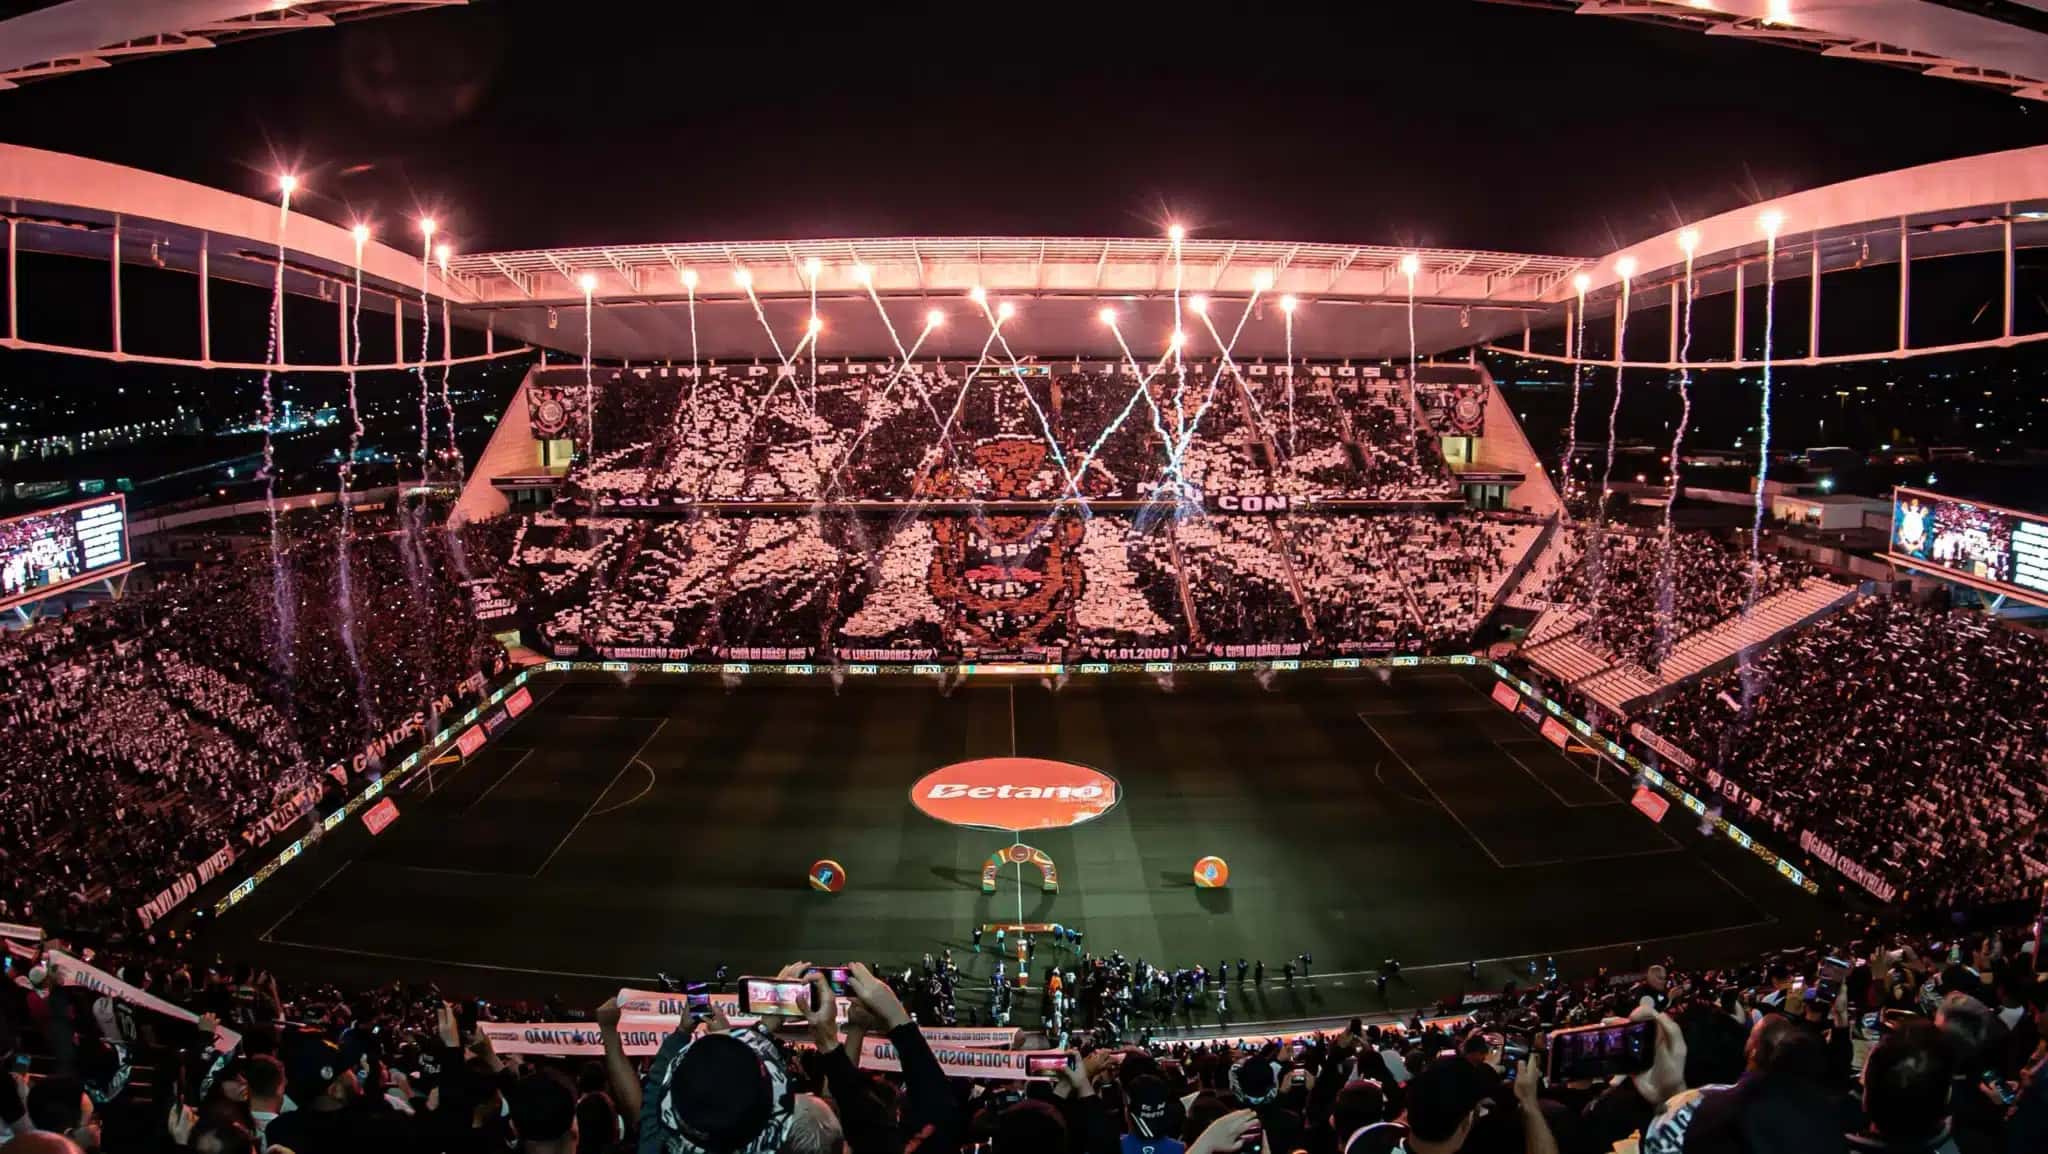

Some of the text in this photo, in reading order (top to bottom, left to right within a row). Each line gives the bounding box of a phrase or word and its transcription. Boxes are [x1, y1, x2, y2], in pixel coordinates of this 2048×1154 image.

[632, 366, 727, 379] TIME
[818, 364, 923, 375] POVO
[1103, 648, 1169, 659] 14.01.2000
[927, 784, 1103, 799] Betano
